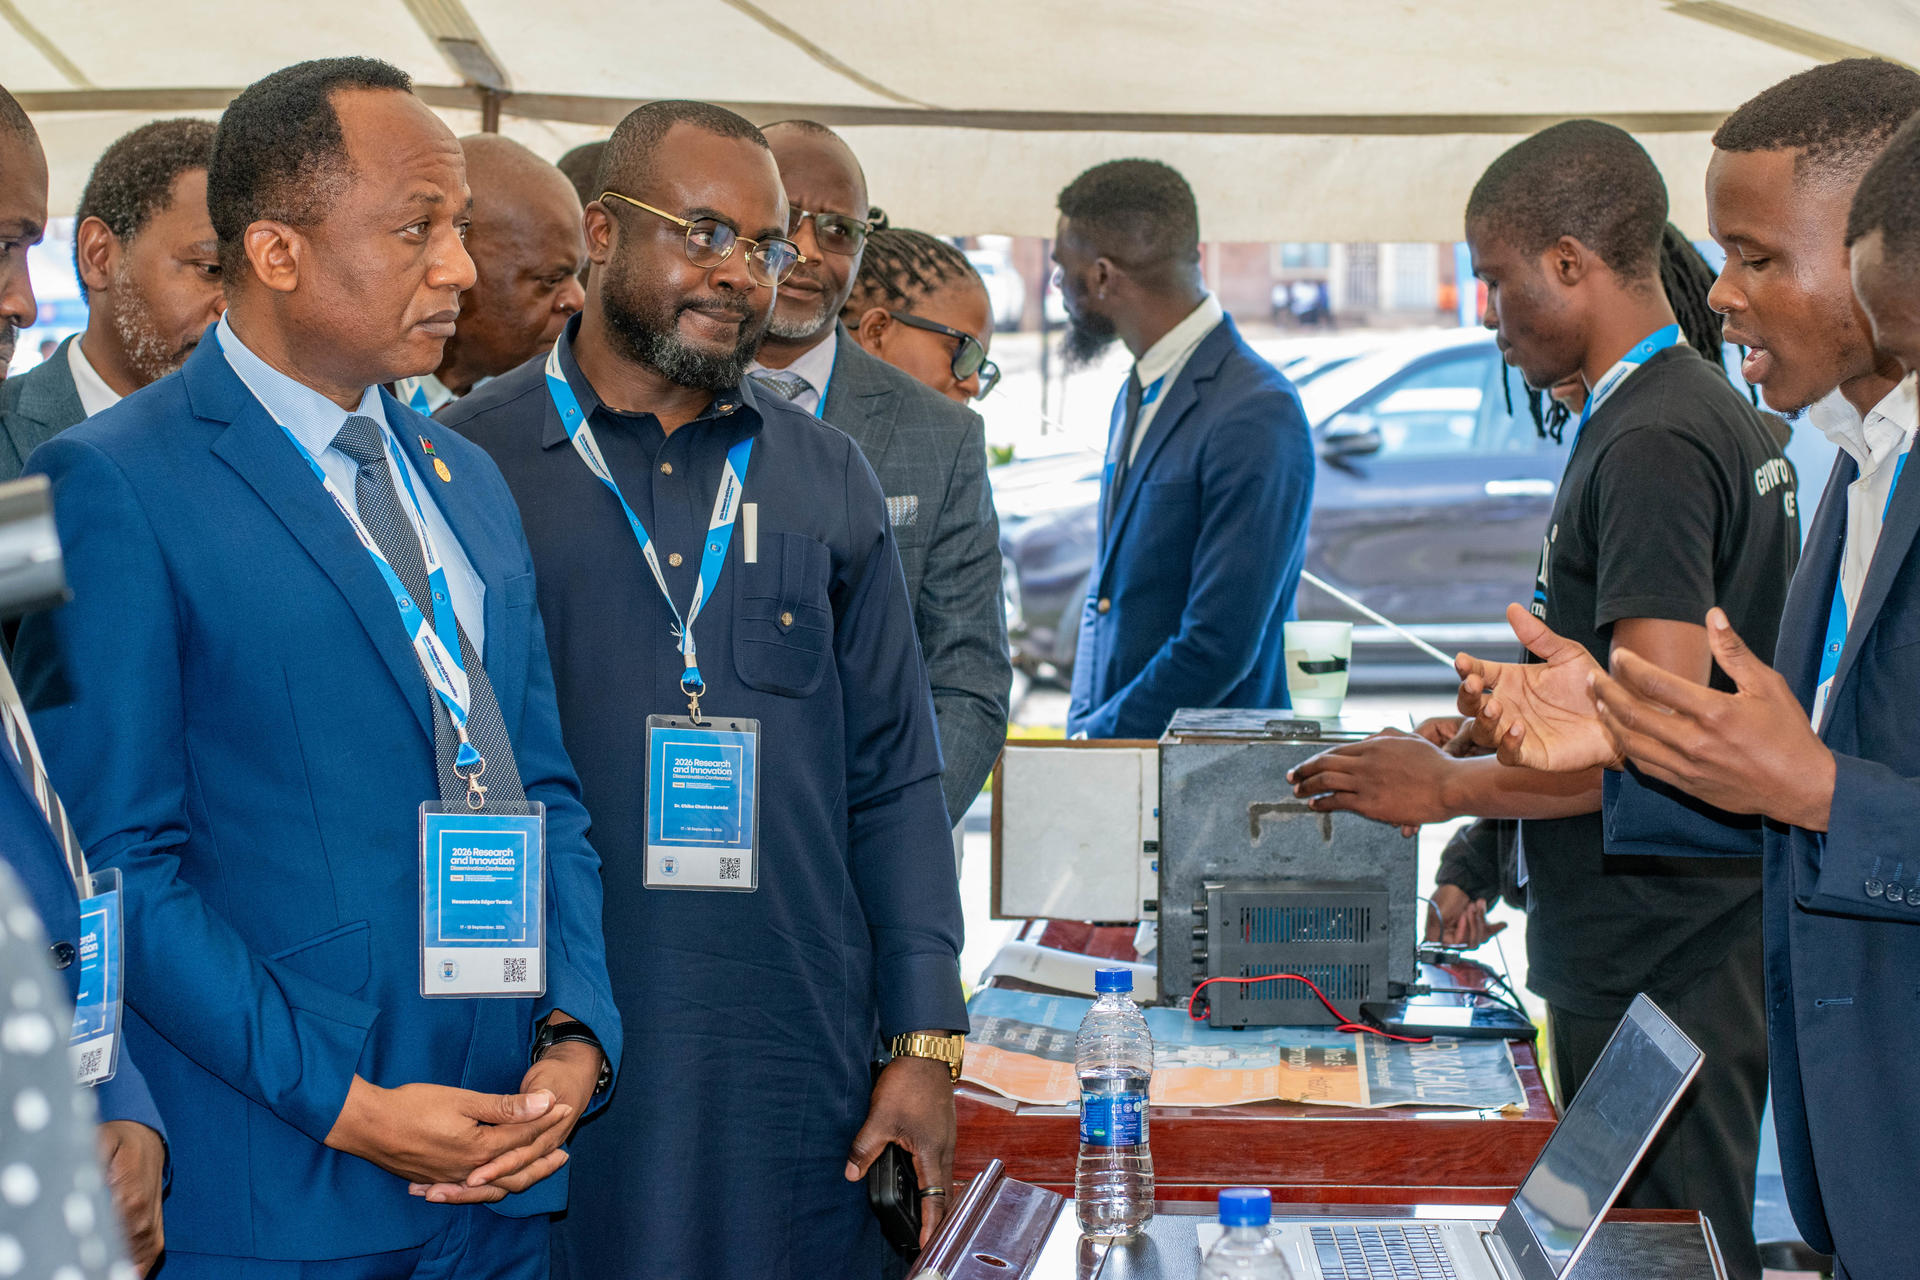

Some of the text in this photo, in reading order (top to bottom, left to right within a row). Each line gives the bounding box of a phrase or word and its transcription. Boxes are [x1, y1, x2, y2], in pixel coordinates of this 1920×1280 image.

[674, 757, 731, 768] 2026 Research
[672, 766, 732, 776] and Innovation
[451, 847, 514, 857] 2026 Research
[450, 856, 516, 865] and Innovation
